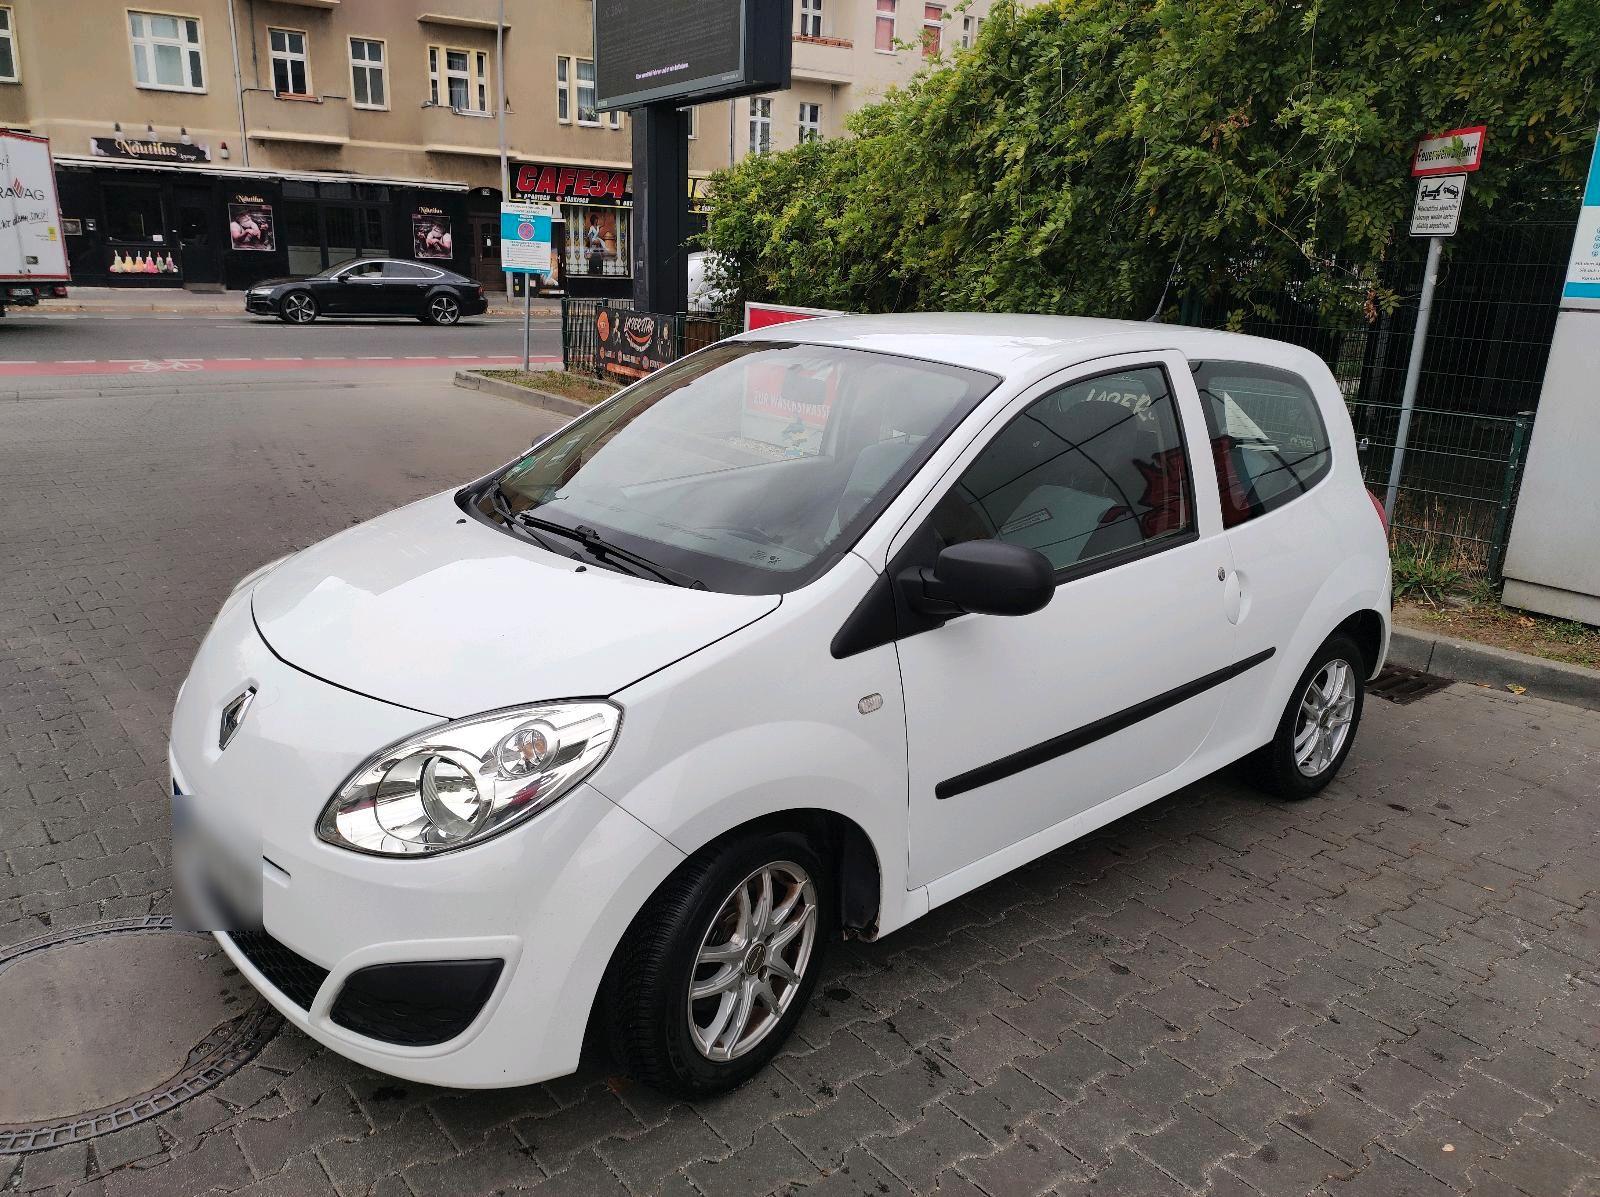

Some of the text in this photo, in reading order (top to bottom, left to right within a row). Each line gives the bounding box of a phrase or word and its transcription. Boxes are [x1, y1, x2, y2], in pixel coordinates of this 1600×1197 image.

[115, 139, 177, 157] Nautilus
[1417, 143, 1478, 162] Feuerwehrahrt
[516, 164, 627, 199] CAFE34
